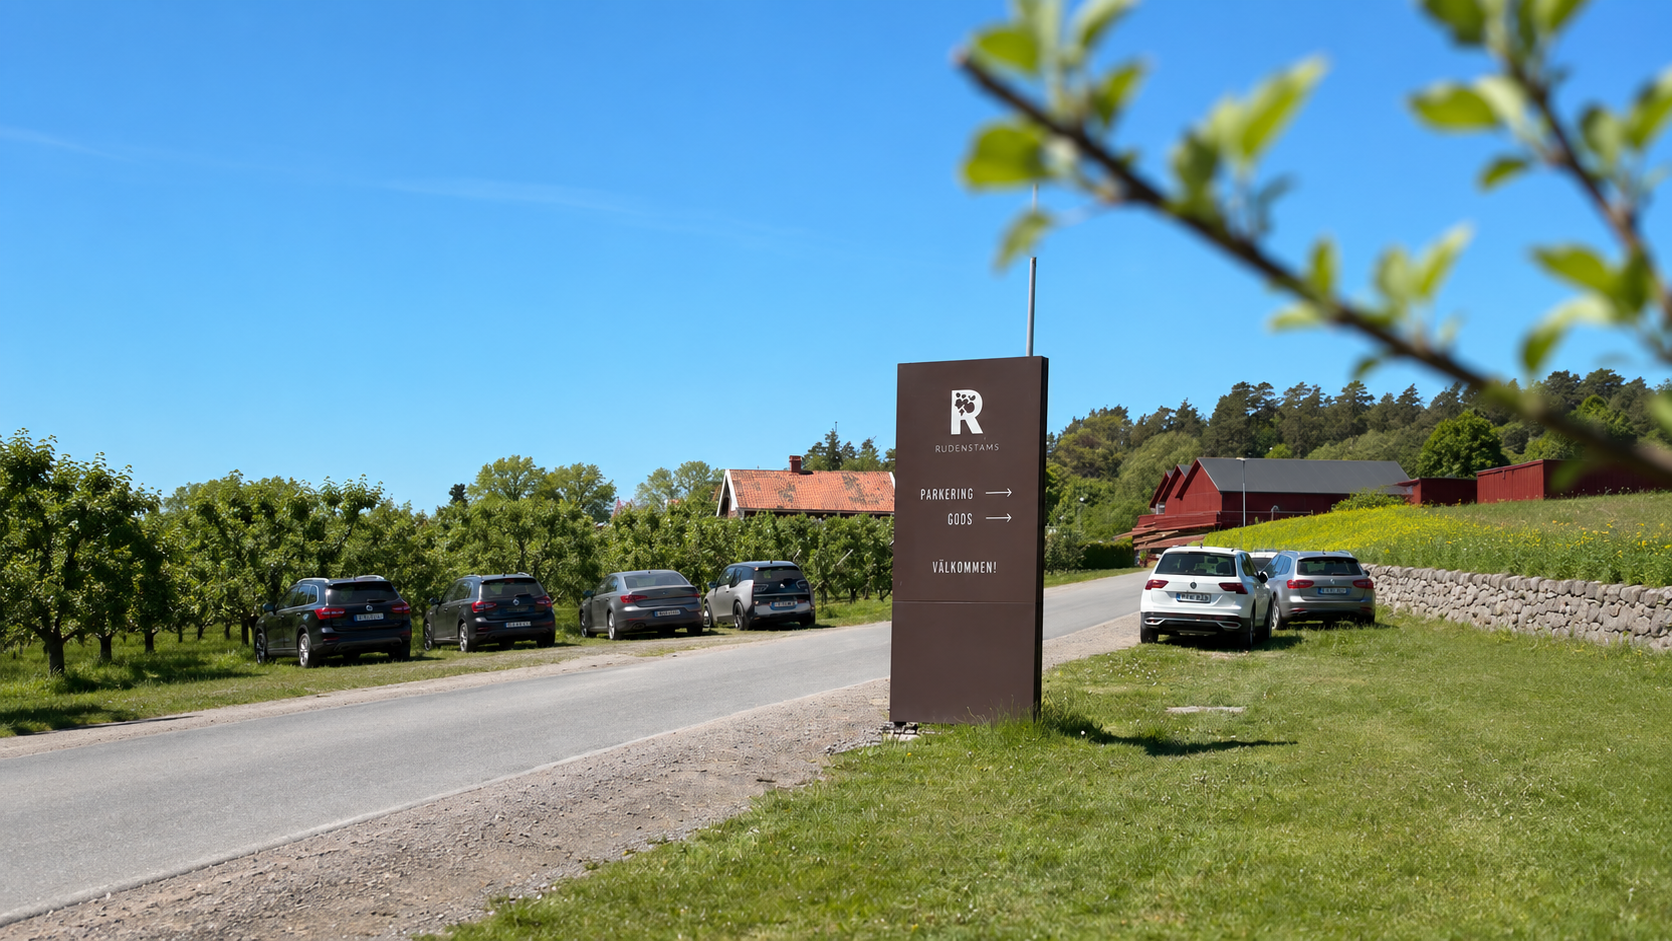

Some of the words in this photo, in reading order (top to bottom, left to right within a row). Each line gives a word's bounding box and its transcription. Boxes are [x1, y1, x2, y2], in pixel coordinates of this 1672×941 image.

[951, 389, 984, 435] R
[935, 443, 1000, 453] RUDENSTAMS
[920, 488, 974, 501] PARKERING
[947, 512, 973, 526] GODS
[932, 558, 998, 574] VÄLKOMMEN!
